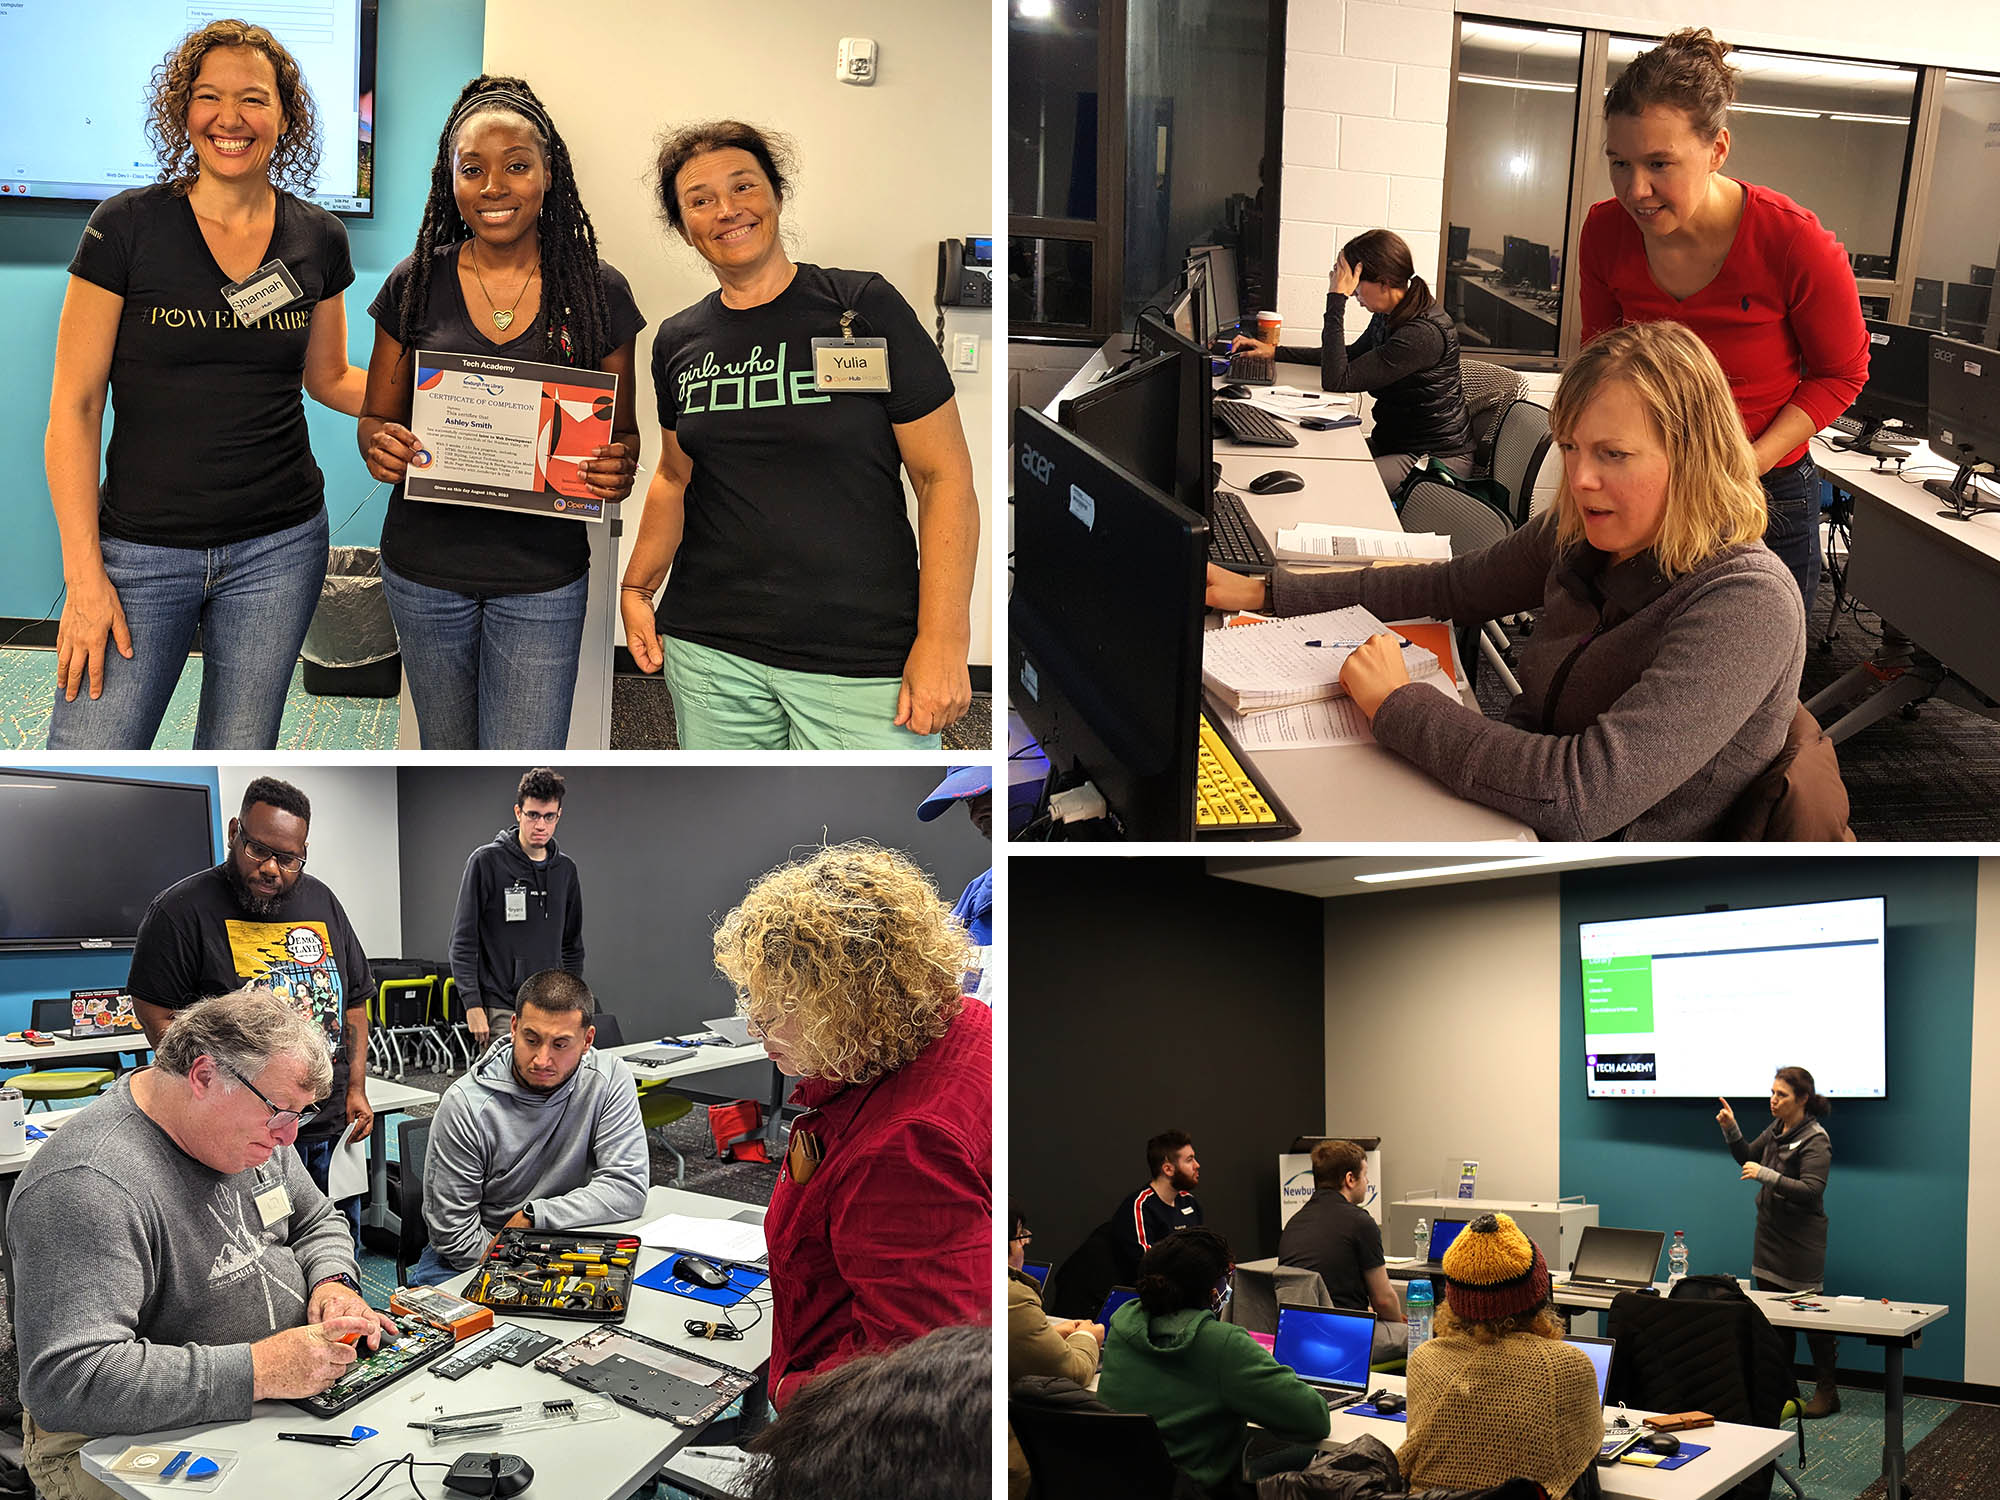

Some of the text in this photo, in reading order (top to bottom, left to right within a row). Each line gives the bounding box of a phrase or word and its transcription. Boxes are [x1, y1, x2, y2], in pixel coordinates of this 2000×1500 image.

[231, 278, 284, 312] Shannah
[833, 356, 868, 369] Yulia
[1934, 348, 1957, 363] acer
[462, 359, 515, 373] Tech Academy
[678, 346, 775, 402] girls who
[429, 392, 475, 404] CERTIFICATE
[488, 400, 535, 411] COMPLETION
[445, 417, 493, 430] Ashley Smith
[1022, 442, 1055, 485] acer
[566, 500, 600, 511] OpenHub
[1596, 1062, 1654, 1073] TECH ACADEMY
[1283, 1186, 1316, 1197] Newbur
